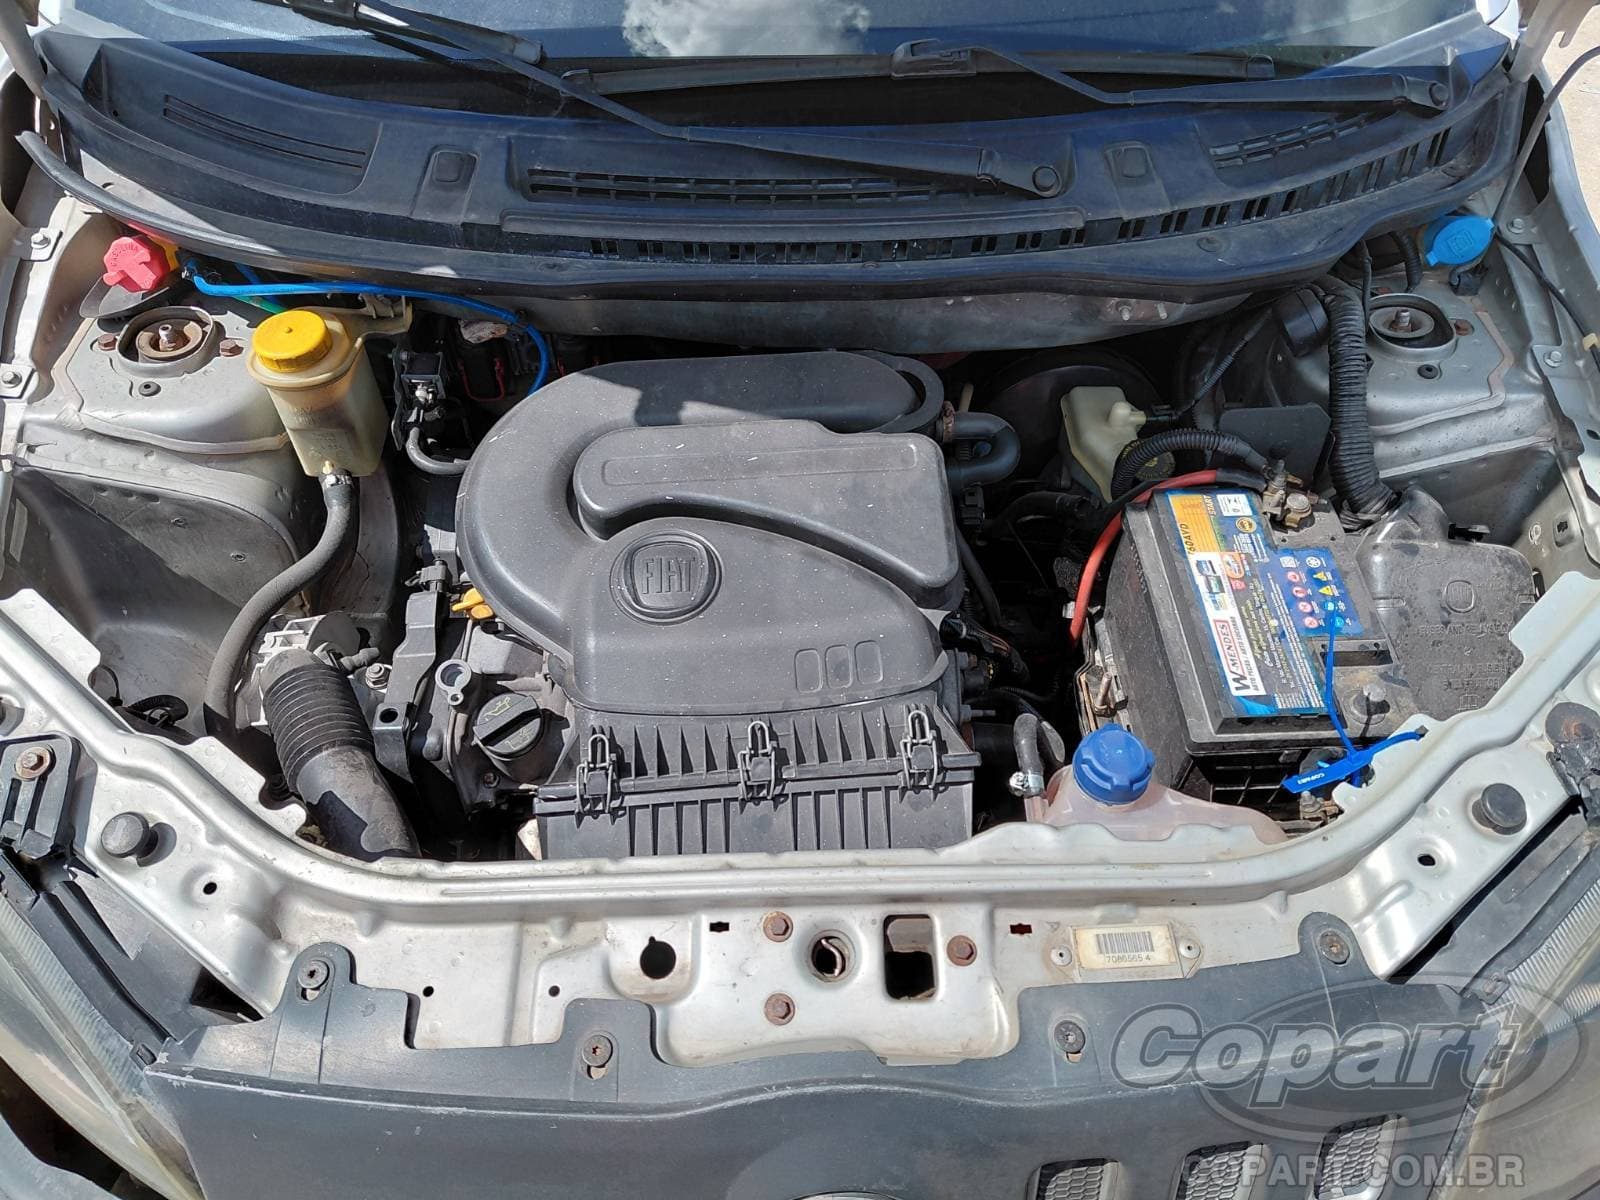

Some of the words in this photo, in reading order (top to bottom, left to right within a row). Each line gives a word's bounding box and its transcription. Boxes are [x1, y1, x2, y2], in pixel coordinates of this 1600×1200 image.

[641, 557, 696, 594] FIAT
[1217, 623, 1239, 668] MENDES
[1228, 670, 1251, 692] W
